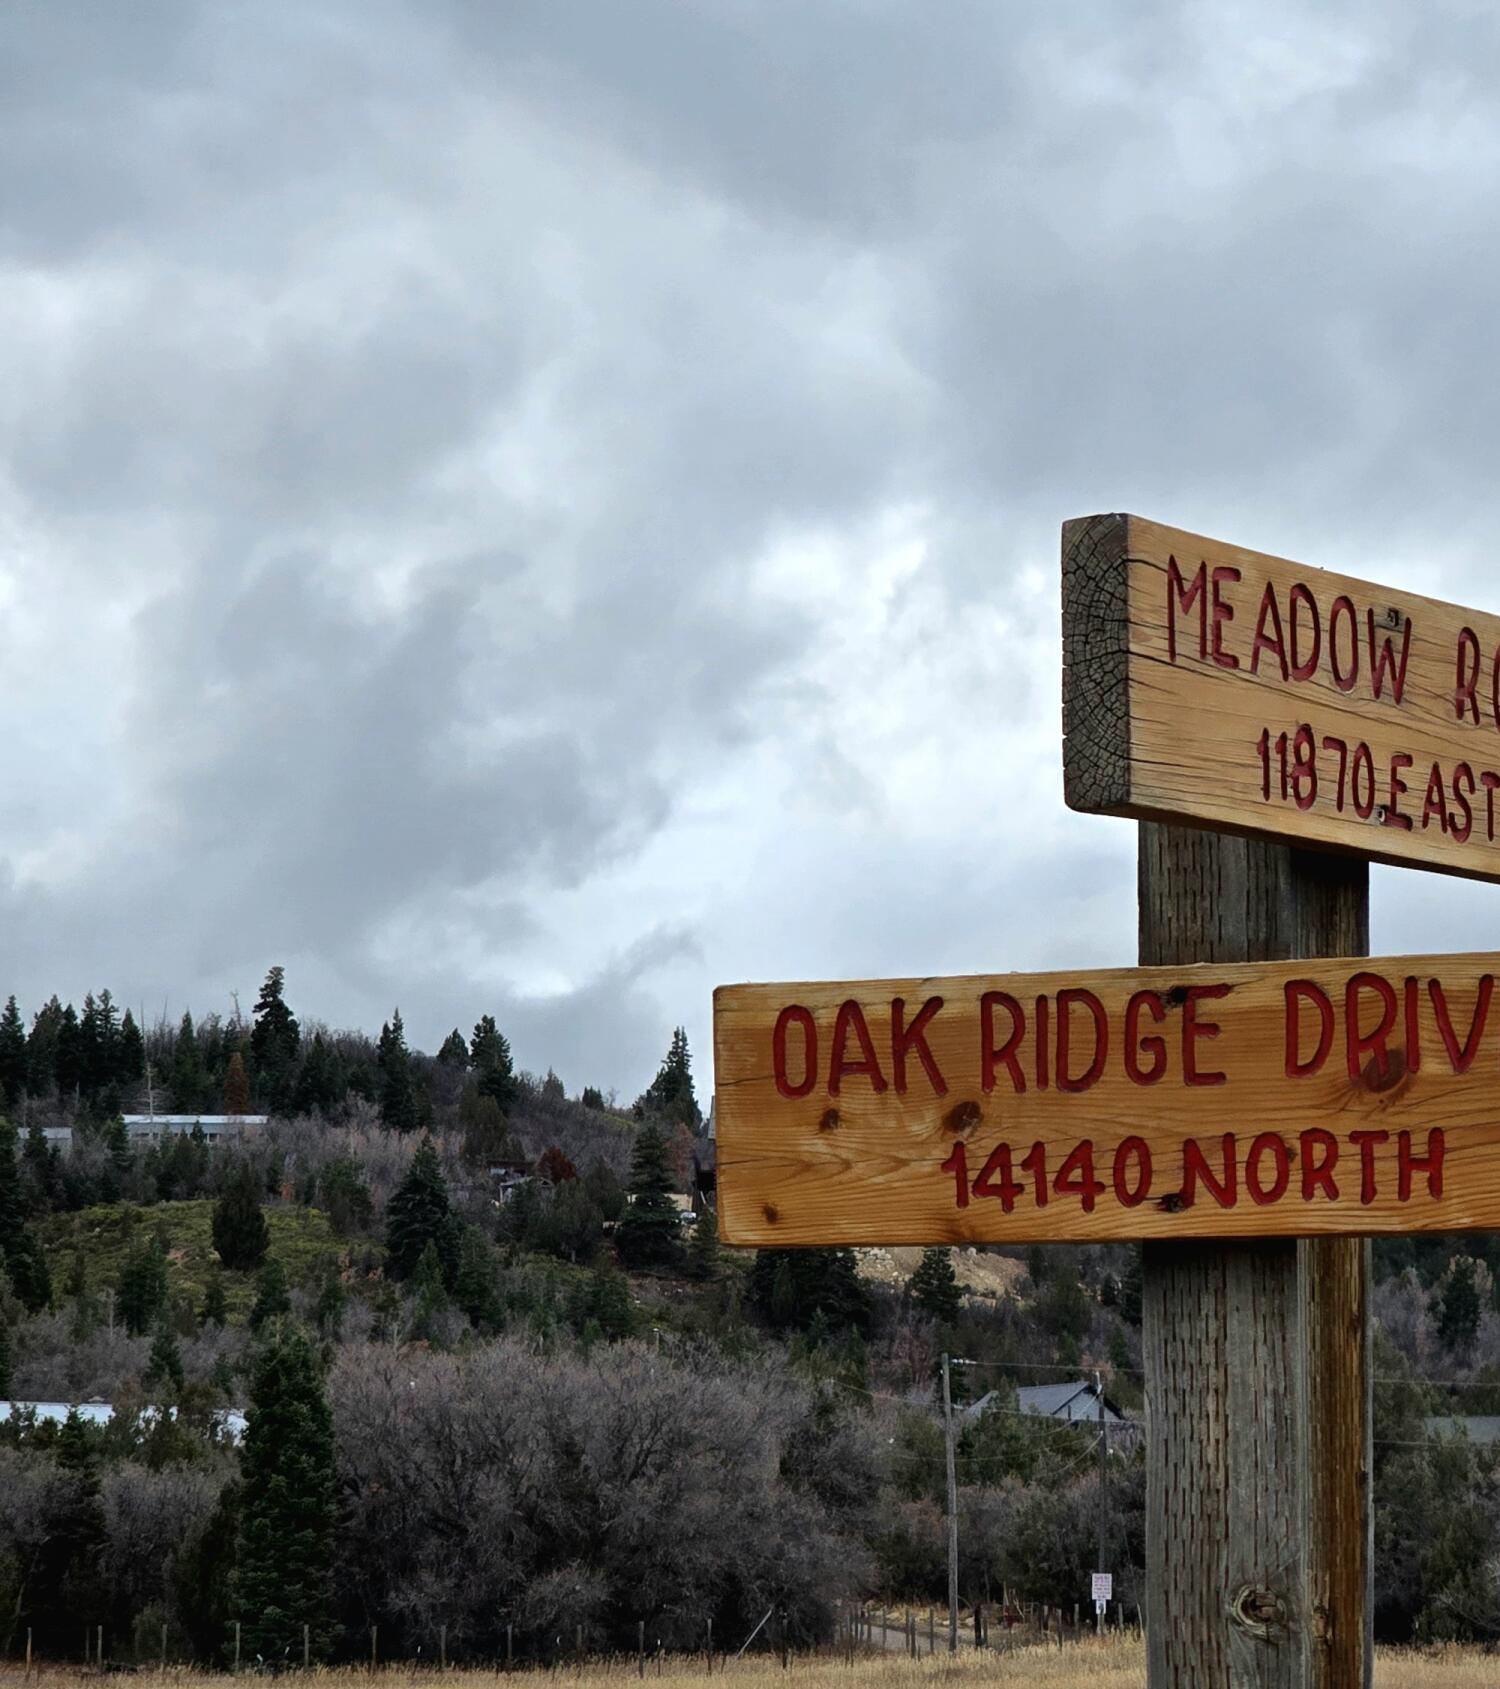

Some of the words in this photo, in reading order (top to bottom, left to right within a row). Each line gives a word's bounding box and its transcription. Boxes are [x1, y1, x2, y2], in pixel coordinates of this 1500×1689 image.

[1166, 554, 1412, 705] MEADOW
[1256, 722, 1376, 820] 11870
[772, 996, 947, 1099] OAK
[980, 984, 1233, 1094] RIDGE
[941, 1134, 1153, 1213] 14140
[1182, 1126, 1446, 1209] NORTH
